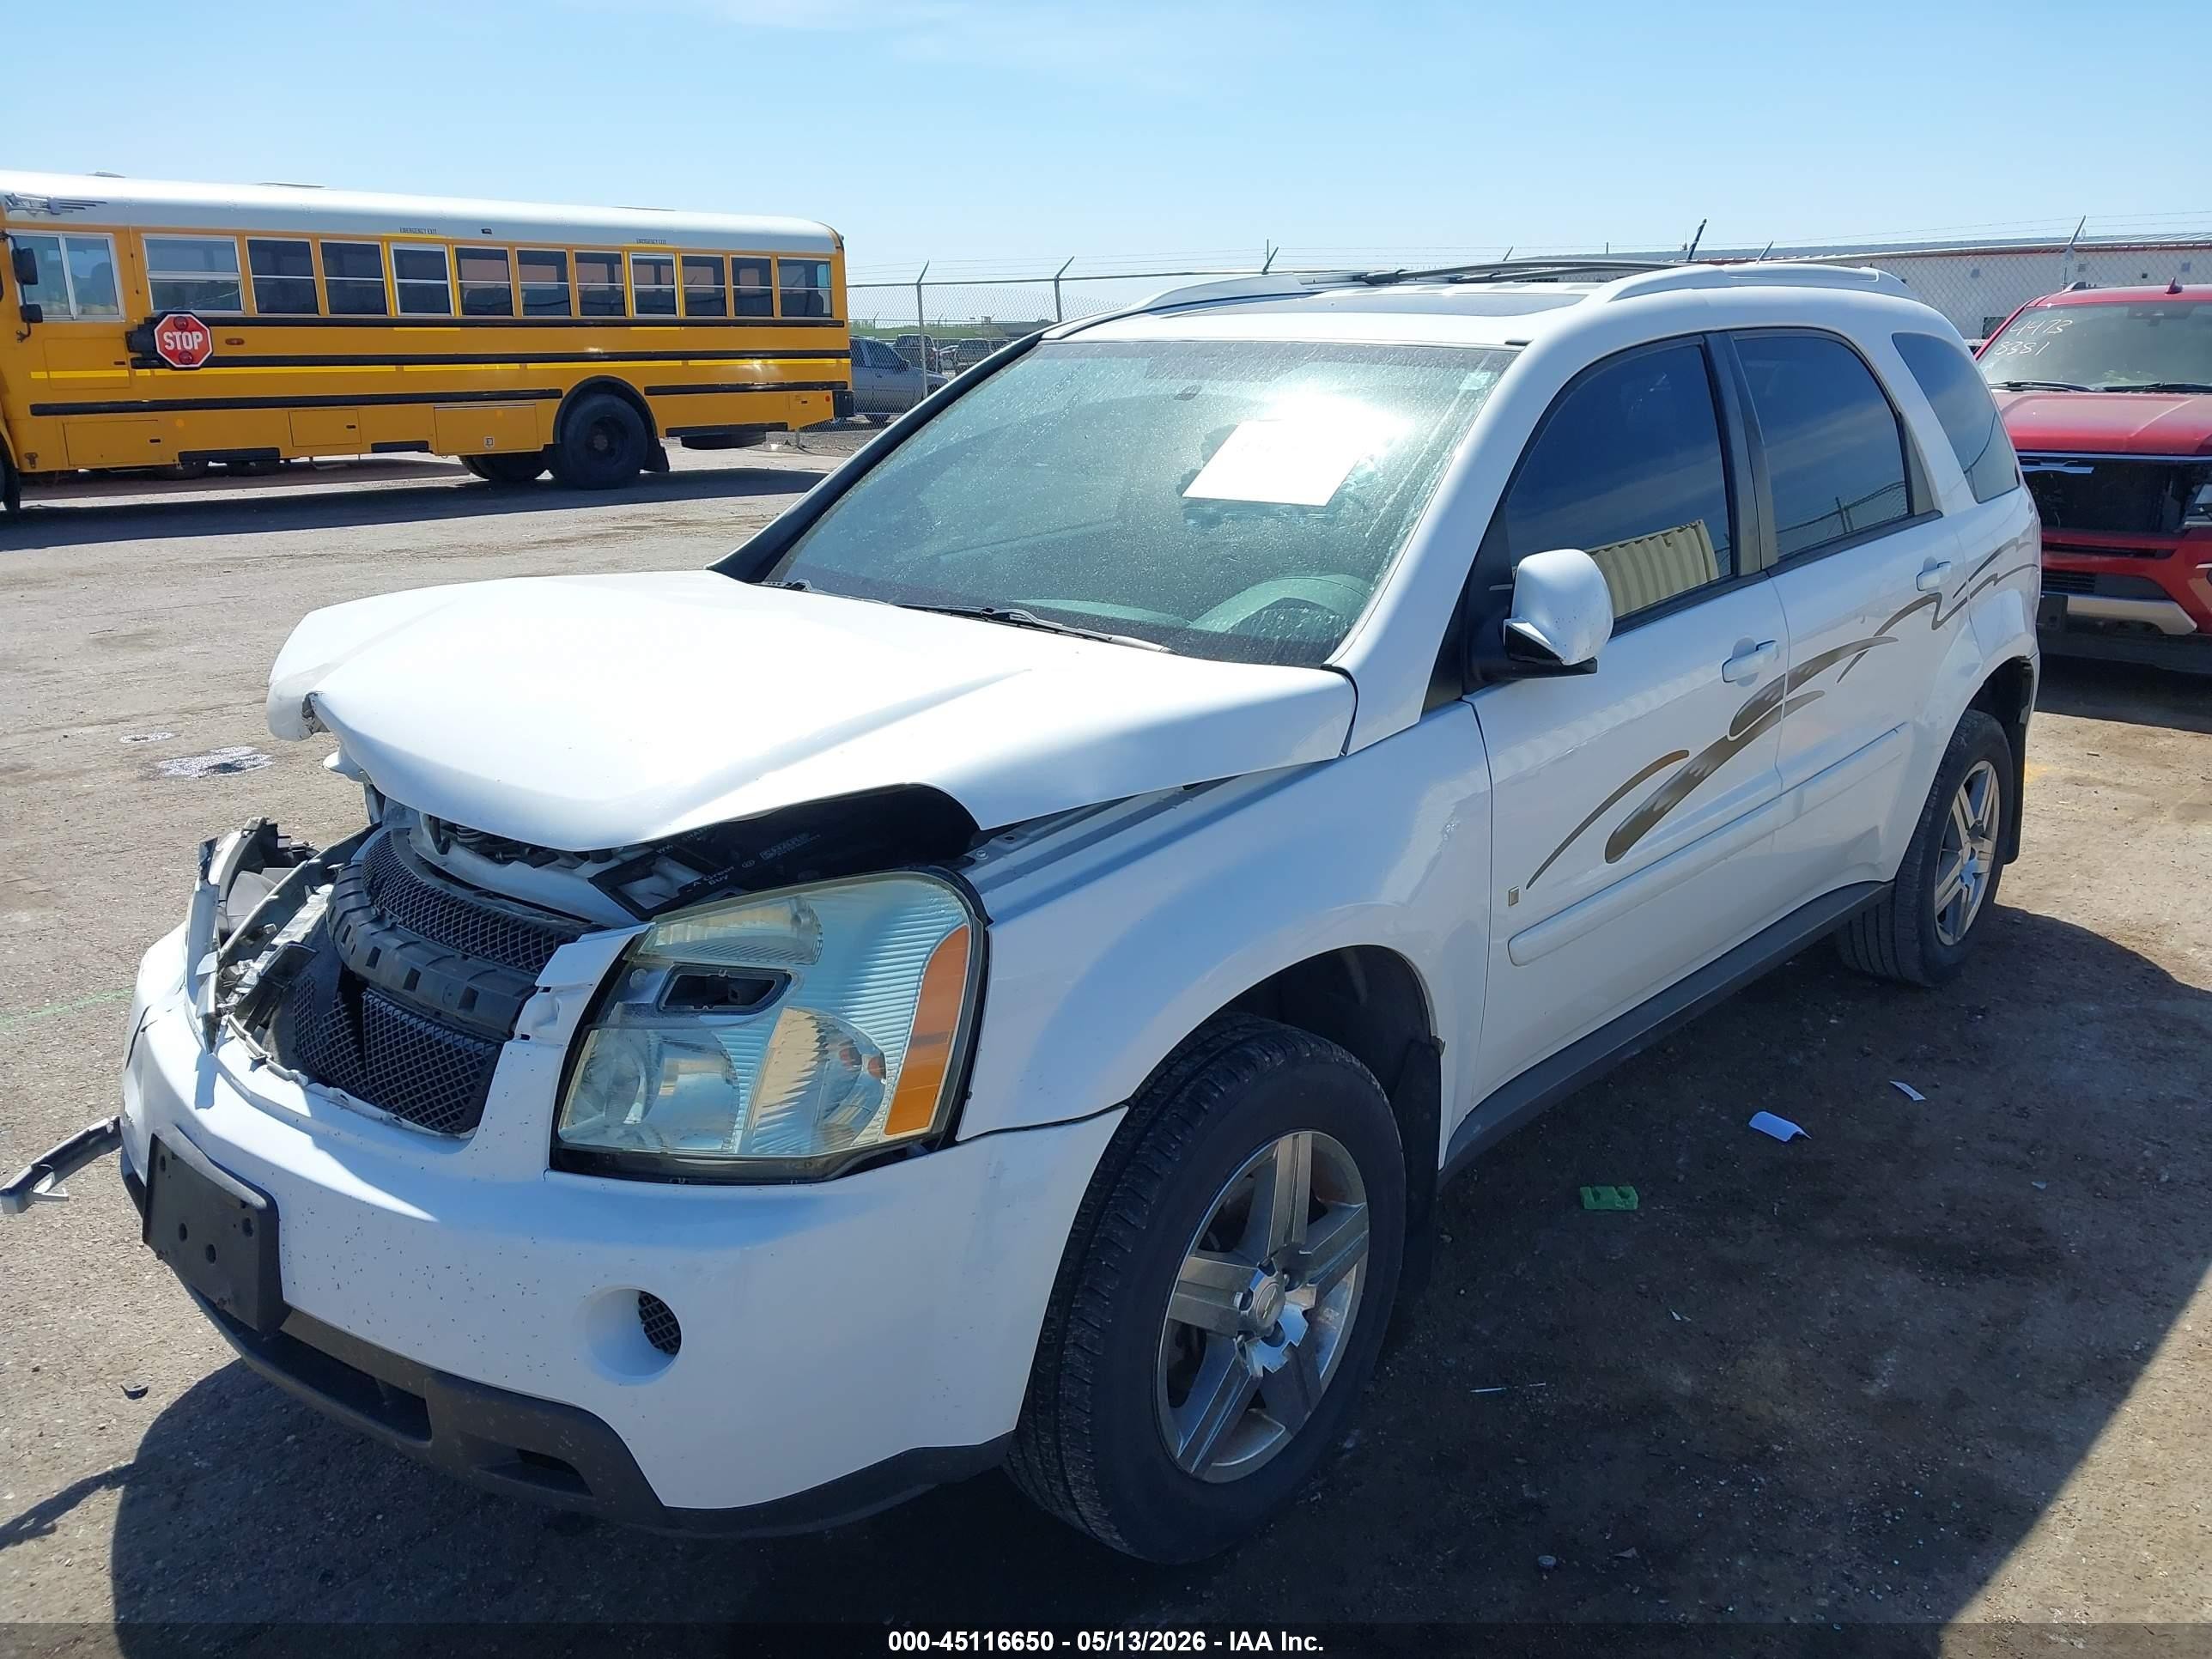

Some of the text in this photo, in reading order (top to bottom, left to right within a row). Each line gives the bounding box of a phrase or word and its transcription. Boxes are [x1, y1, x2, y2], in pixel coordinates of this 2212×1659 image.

[2008, 319, 2073, 337] 4473
[163, 331, 203, 350] STOP
[1994, 341, 2051, 356] 8381
